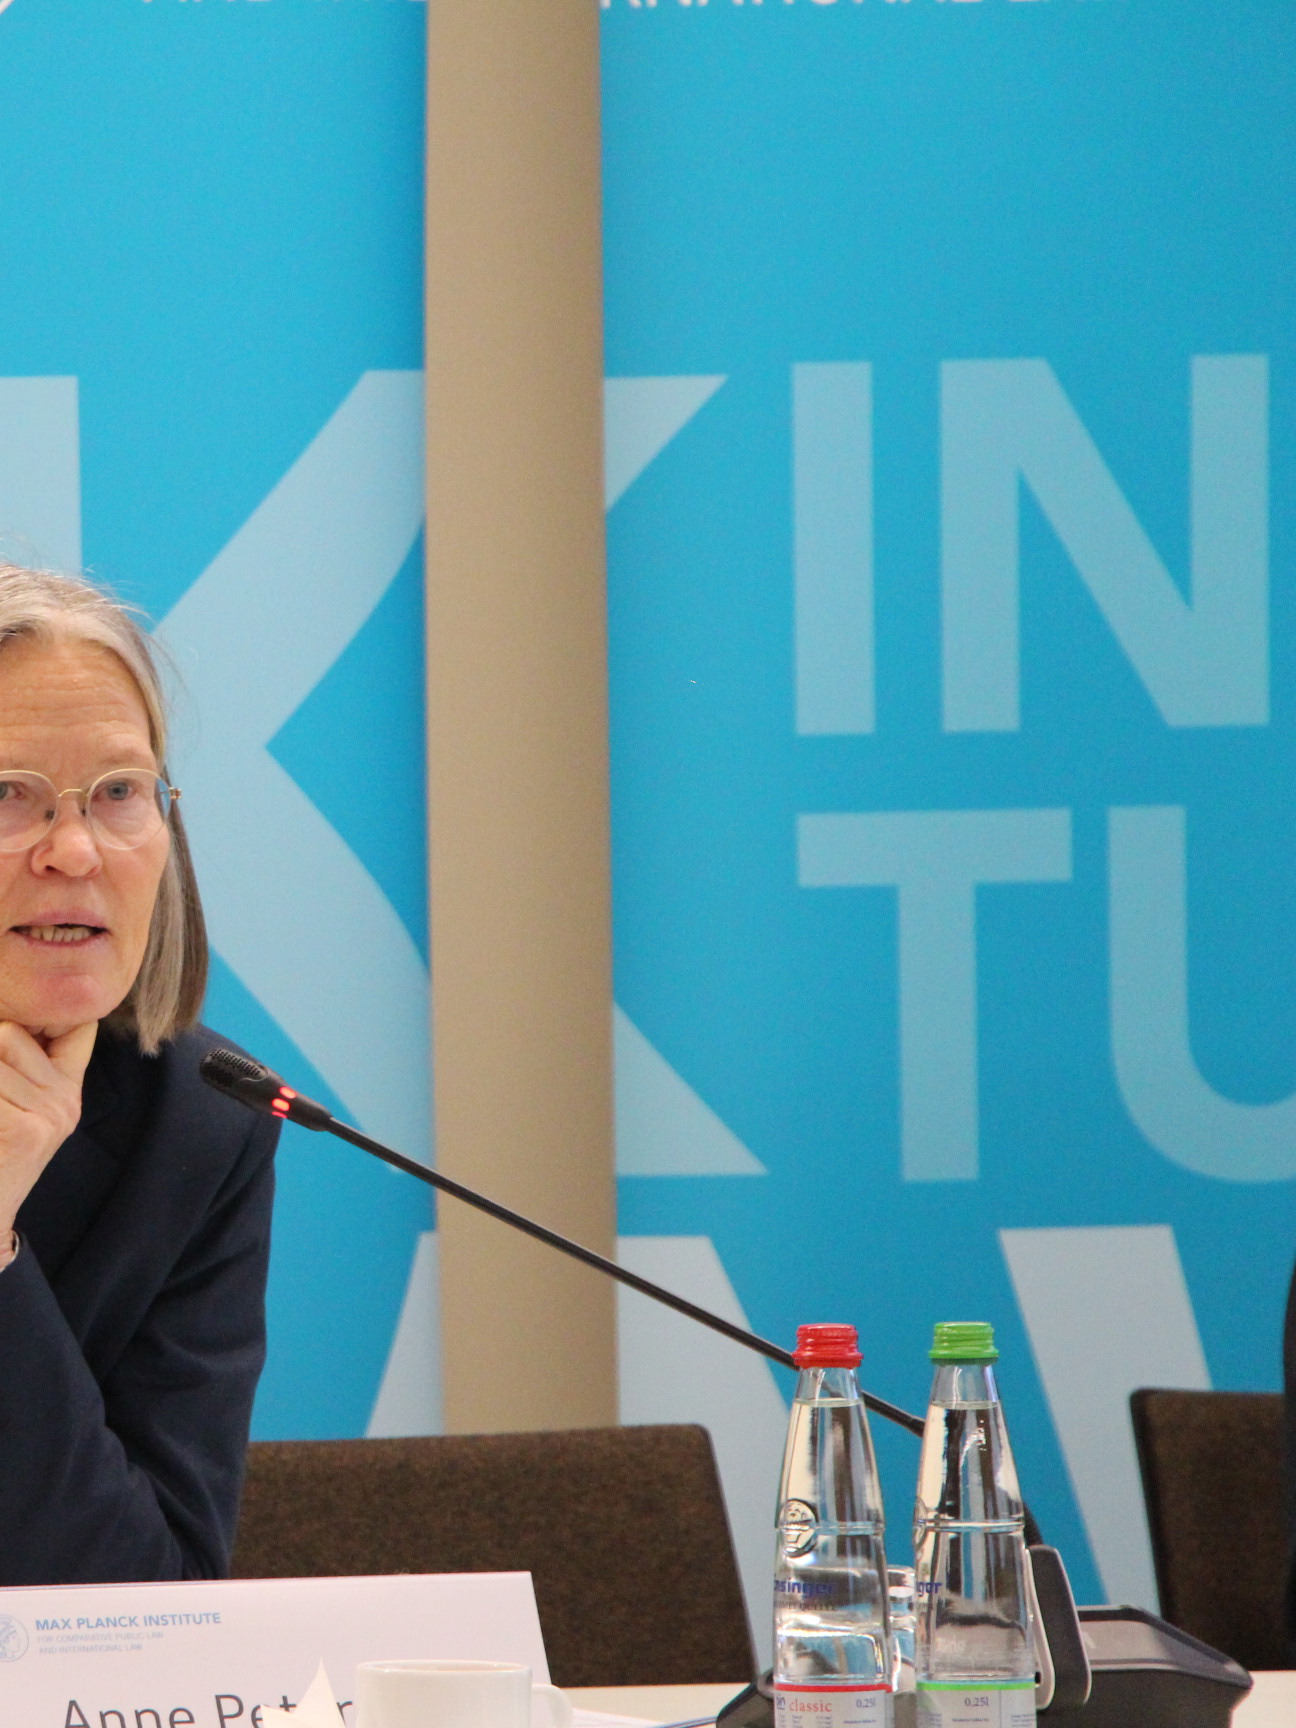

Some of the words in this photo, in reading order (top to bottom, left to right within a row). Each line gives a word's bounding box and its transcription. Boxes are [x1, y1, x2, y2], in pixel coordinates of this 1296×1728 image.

[791, 353, 1270, 736] IN
[35, 1618, 72, 1631] MAX
[76, 1615, 139, 1629] PLANCK
[143, 1612, 221, 1627] INSTITUTE
[64, 1699, 196, 1728] Anne
[789, 1699, 833, 1712] classic
